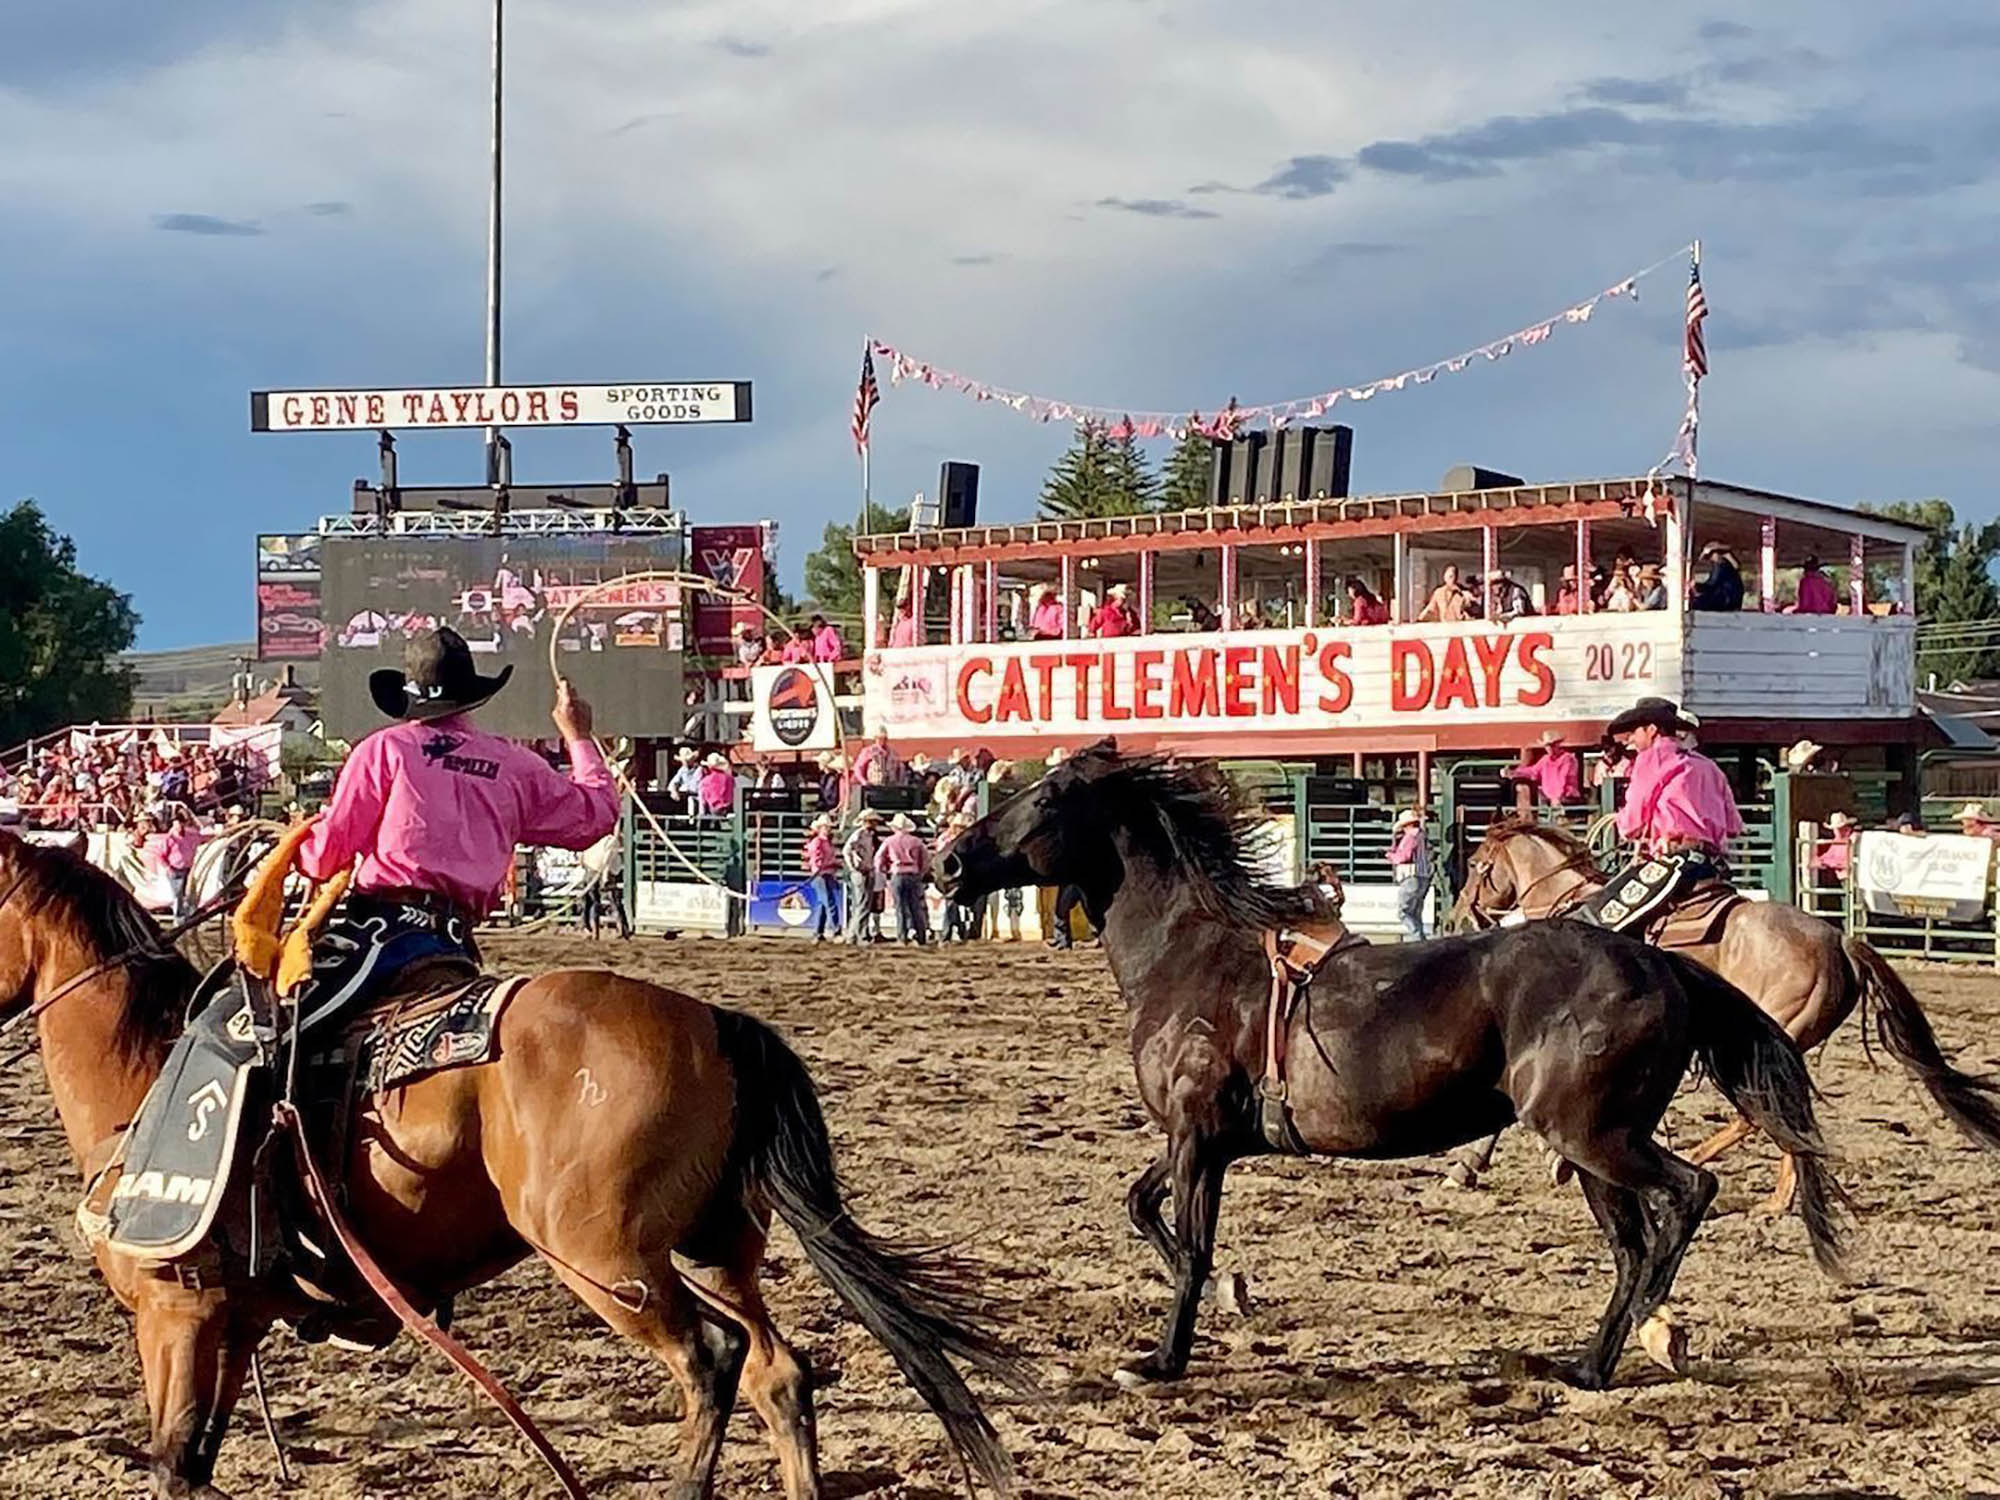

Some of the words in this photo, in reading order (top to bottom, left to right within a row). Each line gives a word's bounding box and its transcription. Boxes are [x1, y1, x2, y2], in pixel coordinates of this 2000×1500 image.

[606, 387, 721, 403] SPORTING
[283, 394, 385, 426] GENE
[627, 404, 701, 420] GOODS
[956, 632, 1353, 724] CATTLEMEN'S
[1391, 632, 1556, 712] DAYS
